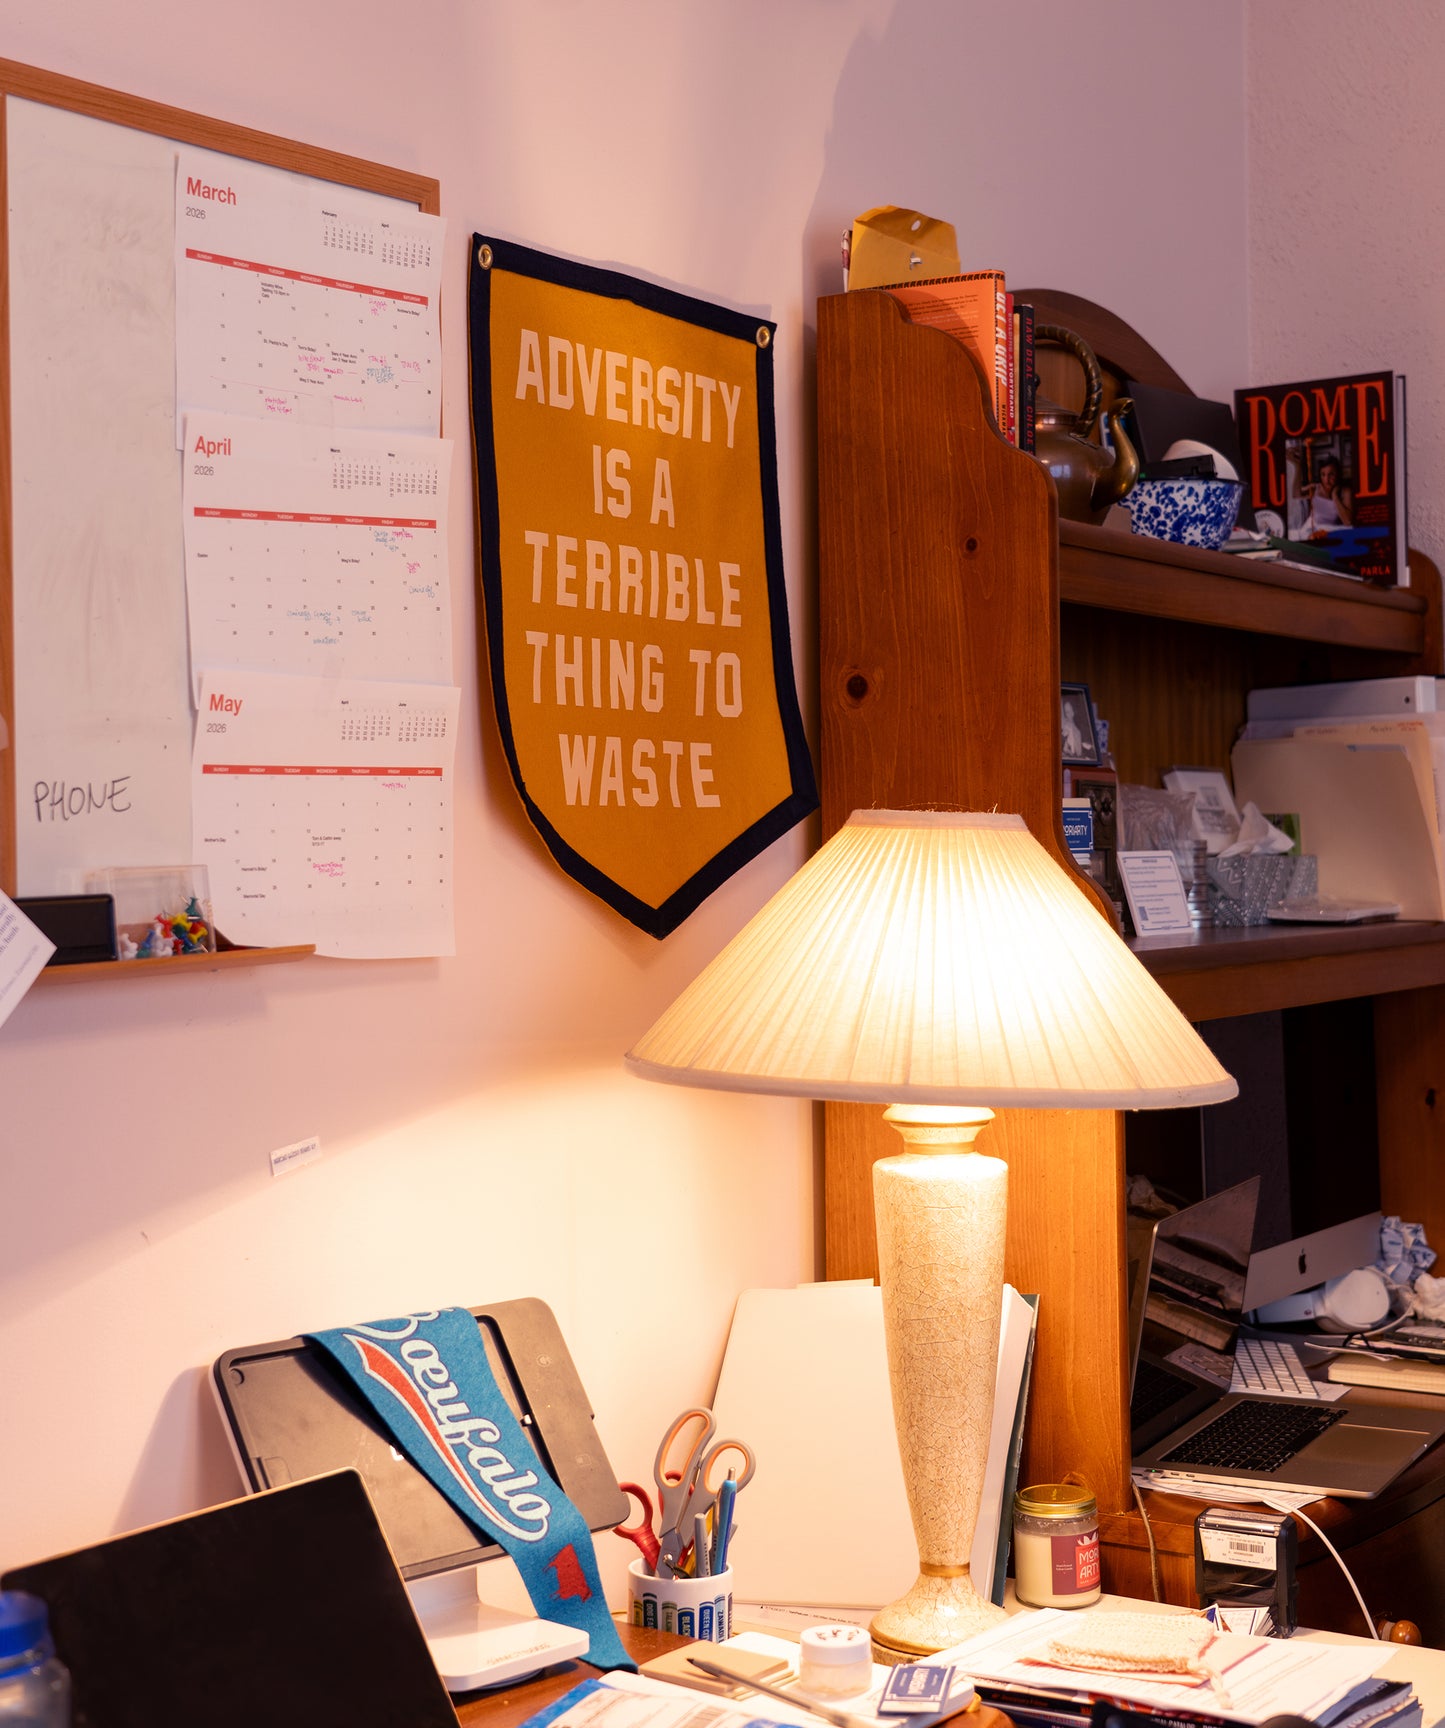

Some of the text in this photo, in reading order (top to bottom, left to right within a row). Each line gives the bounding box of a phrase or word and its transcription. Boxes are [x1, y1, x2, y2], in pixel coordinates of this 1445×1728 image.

[187, 176, 237, 206] March
[186, 206, 206, 220] 2026
[515, 328, 741, 449] ADVERSITY
[195, 435, 231, 458] April
[1245, 380, 1388, 509] ROME
[194, 465, 214, 476] 2026
[593, 444, 675, 528] IS A
[525, 530, 742, 627] TERRIBLE
[1360, 565, 1391, 576] PARLA
[525, 631, 743, 718] THING TO
[209, 693, 243, 717] May
[206, 723, 227, 733] 2026
[558, 734, 721, 808] WASTE
[34, 776, 131, 822] PHONE
[1063, 825, 1088, 836] ORIARTY
[716, 1609, 724, 1638] ZAWADI
